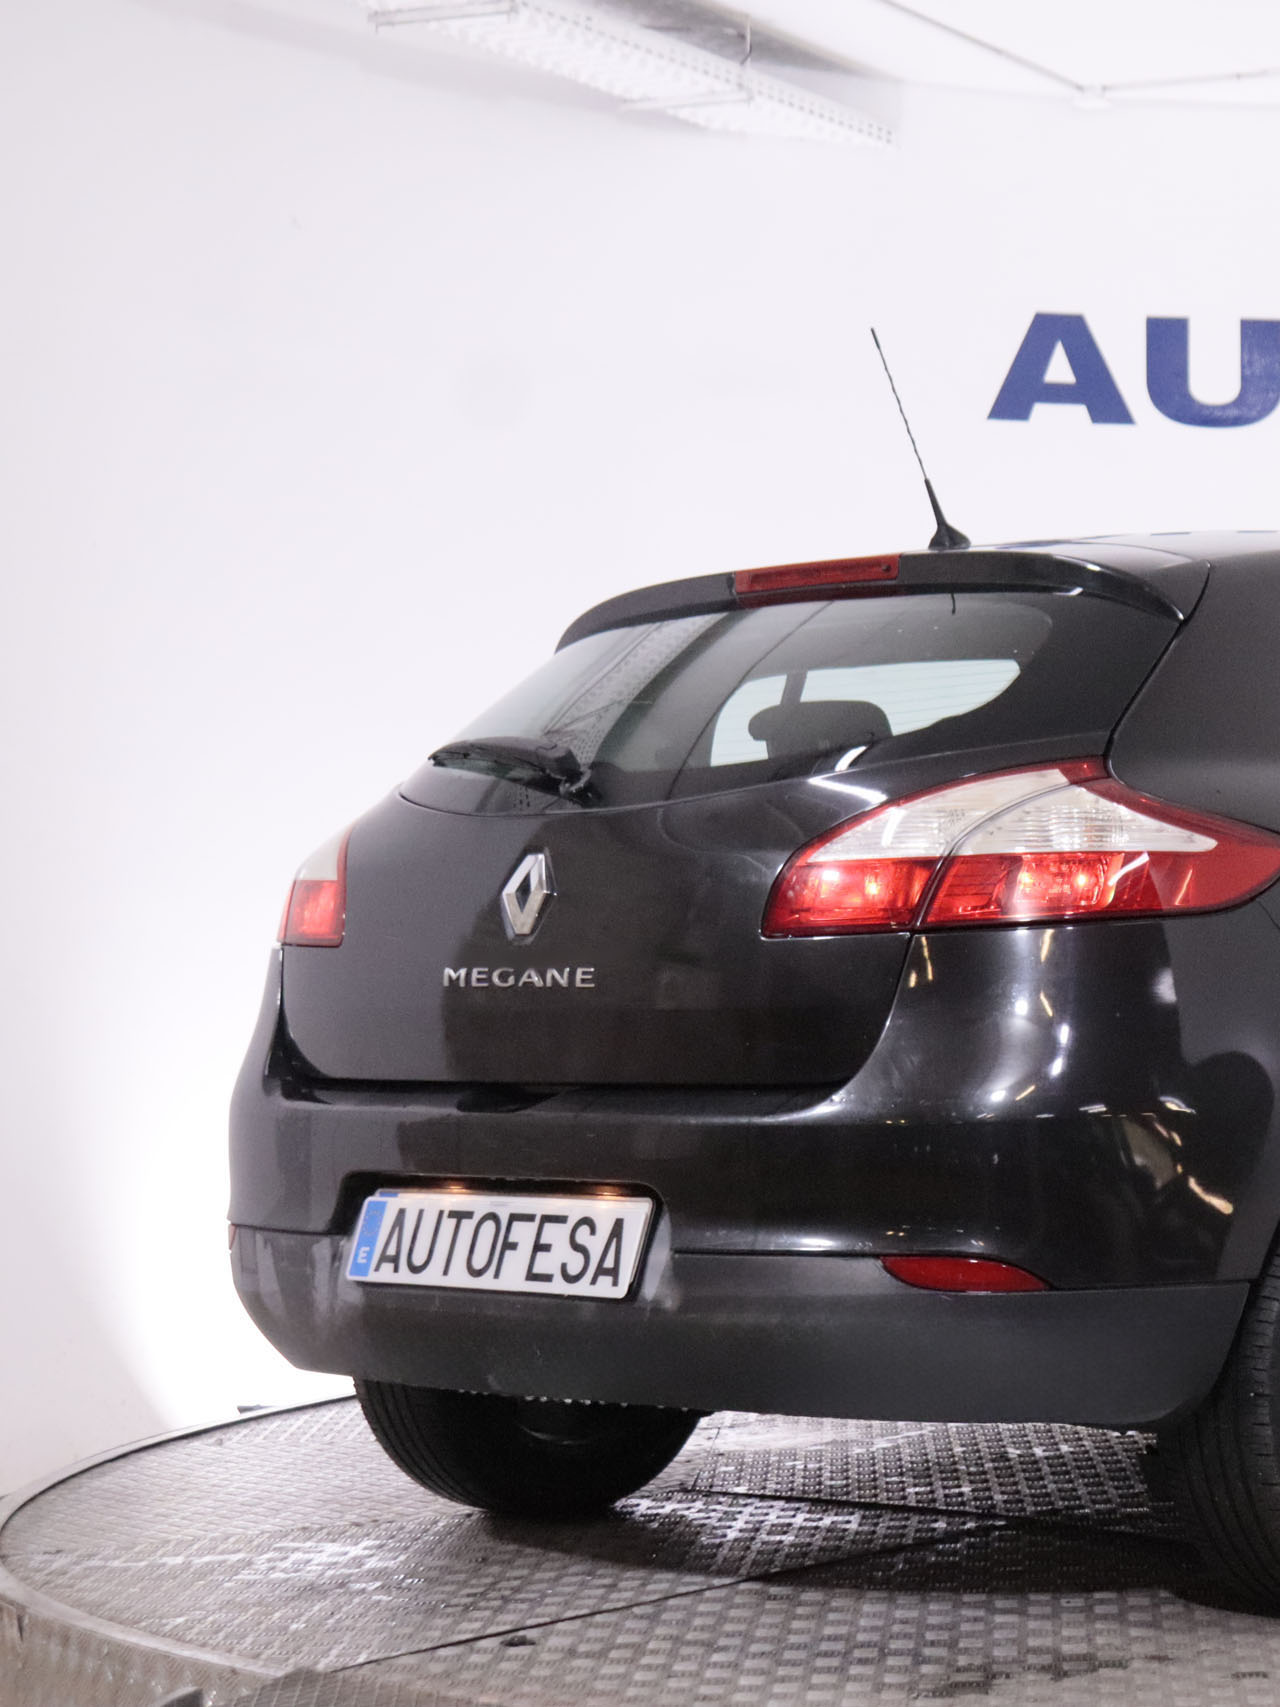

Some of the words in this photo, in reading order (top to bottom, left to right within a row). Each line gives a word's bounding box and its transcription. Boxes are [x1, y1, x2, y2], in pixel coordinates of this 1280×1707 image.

[442, 966, 596, 988] MEGANE
[357, 1246, 371, 1264] E
[374, 1207, 625, 1288] AUTOFESA
